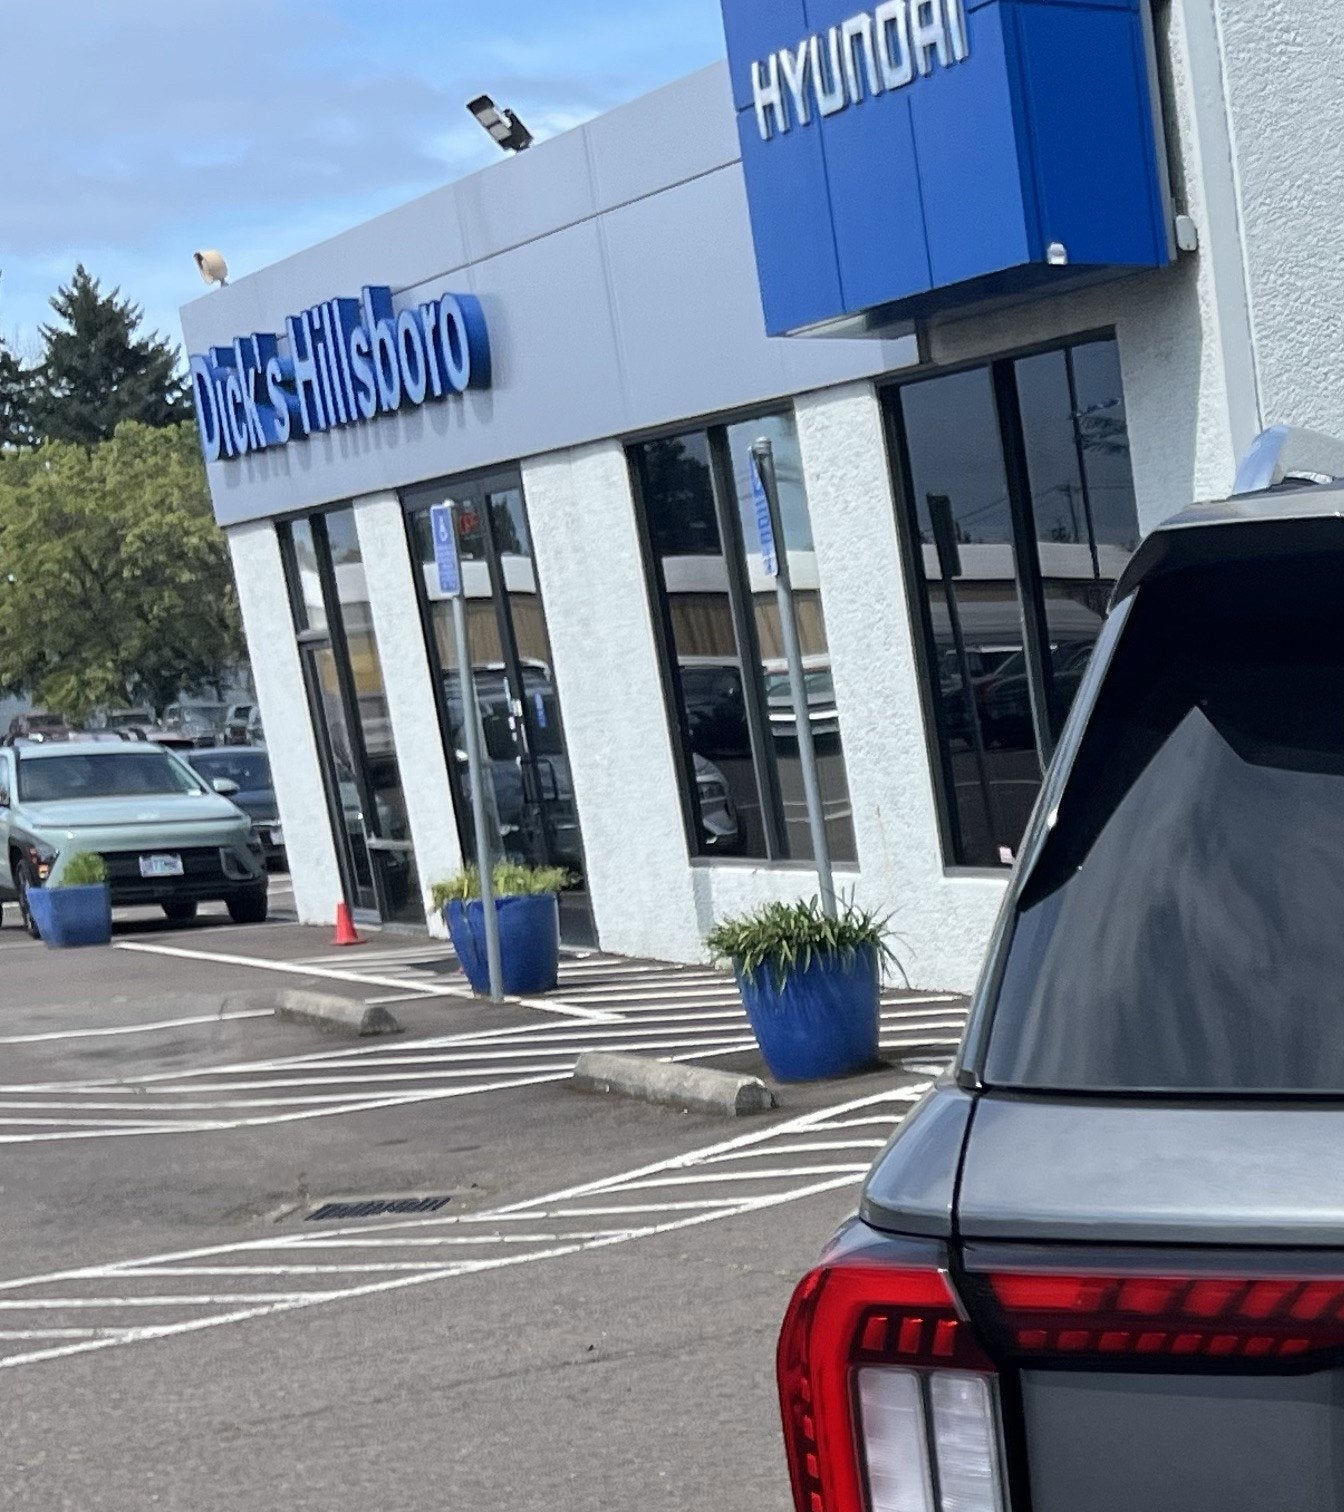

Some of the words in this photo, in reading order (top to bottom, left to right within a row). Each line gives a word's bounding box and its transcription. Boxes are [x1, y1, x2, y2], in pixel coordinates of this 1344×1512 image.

[751, 0, 969, 141] HYUNDAI
[190, 331, 290, 463] Dick's
[285, 284, 478, 435] Hillsboro
